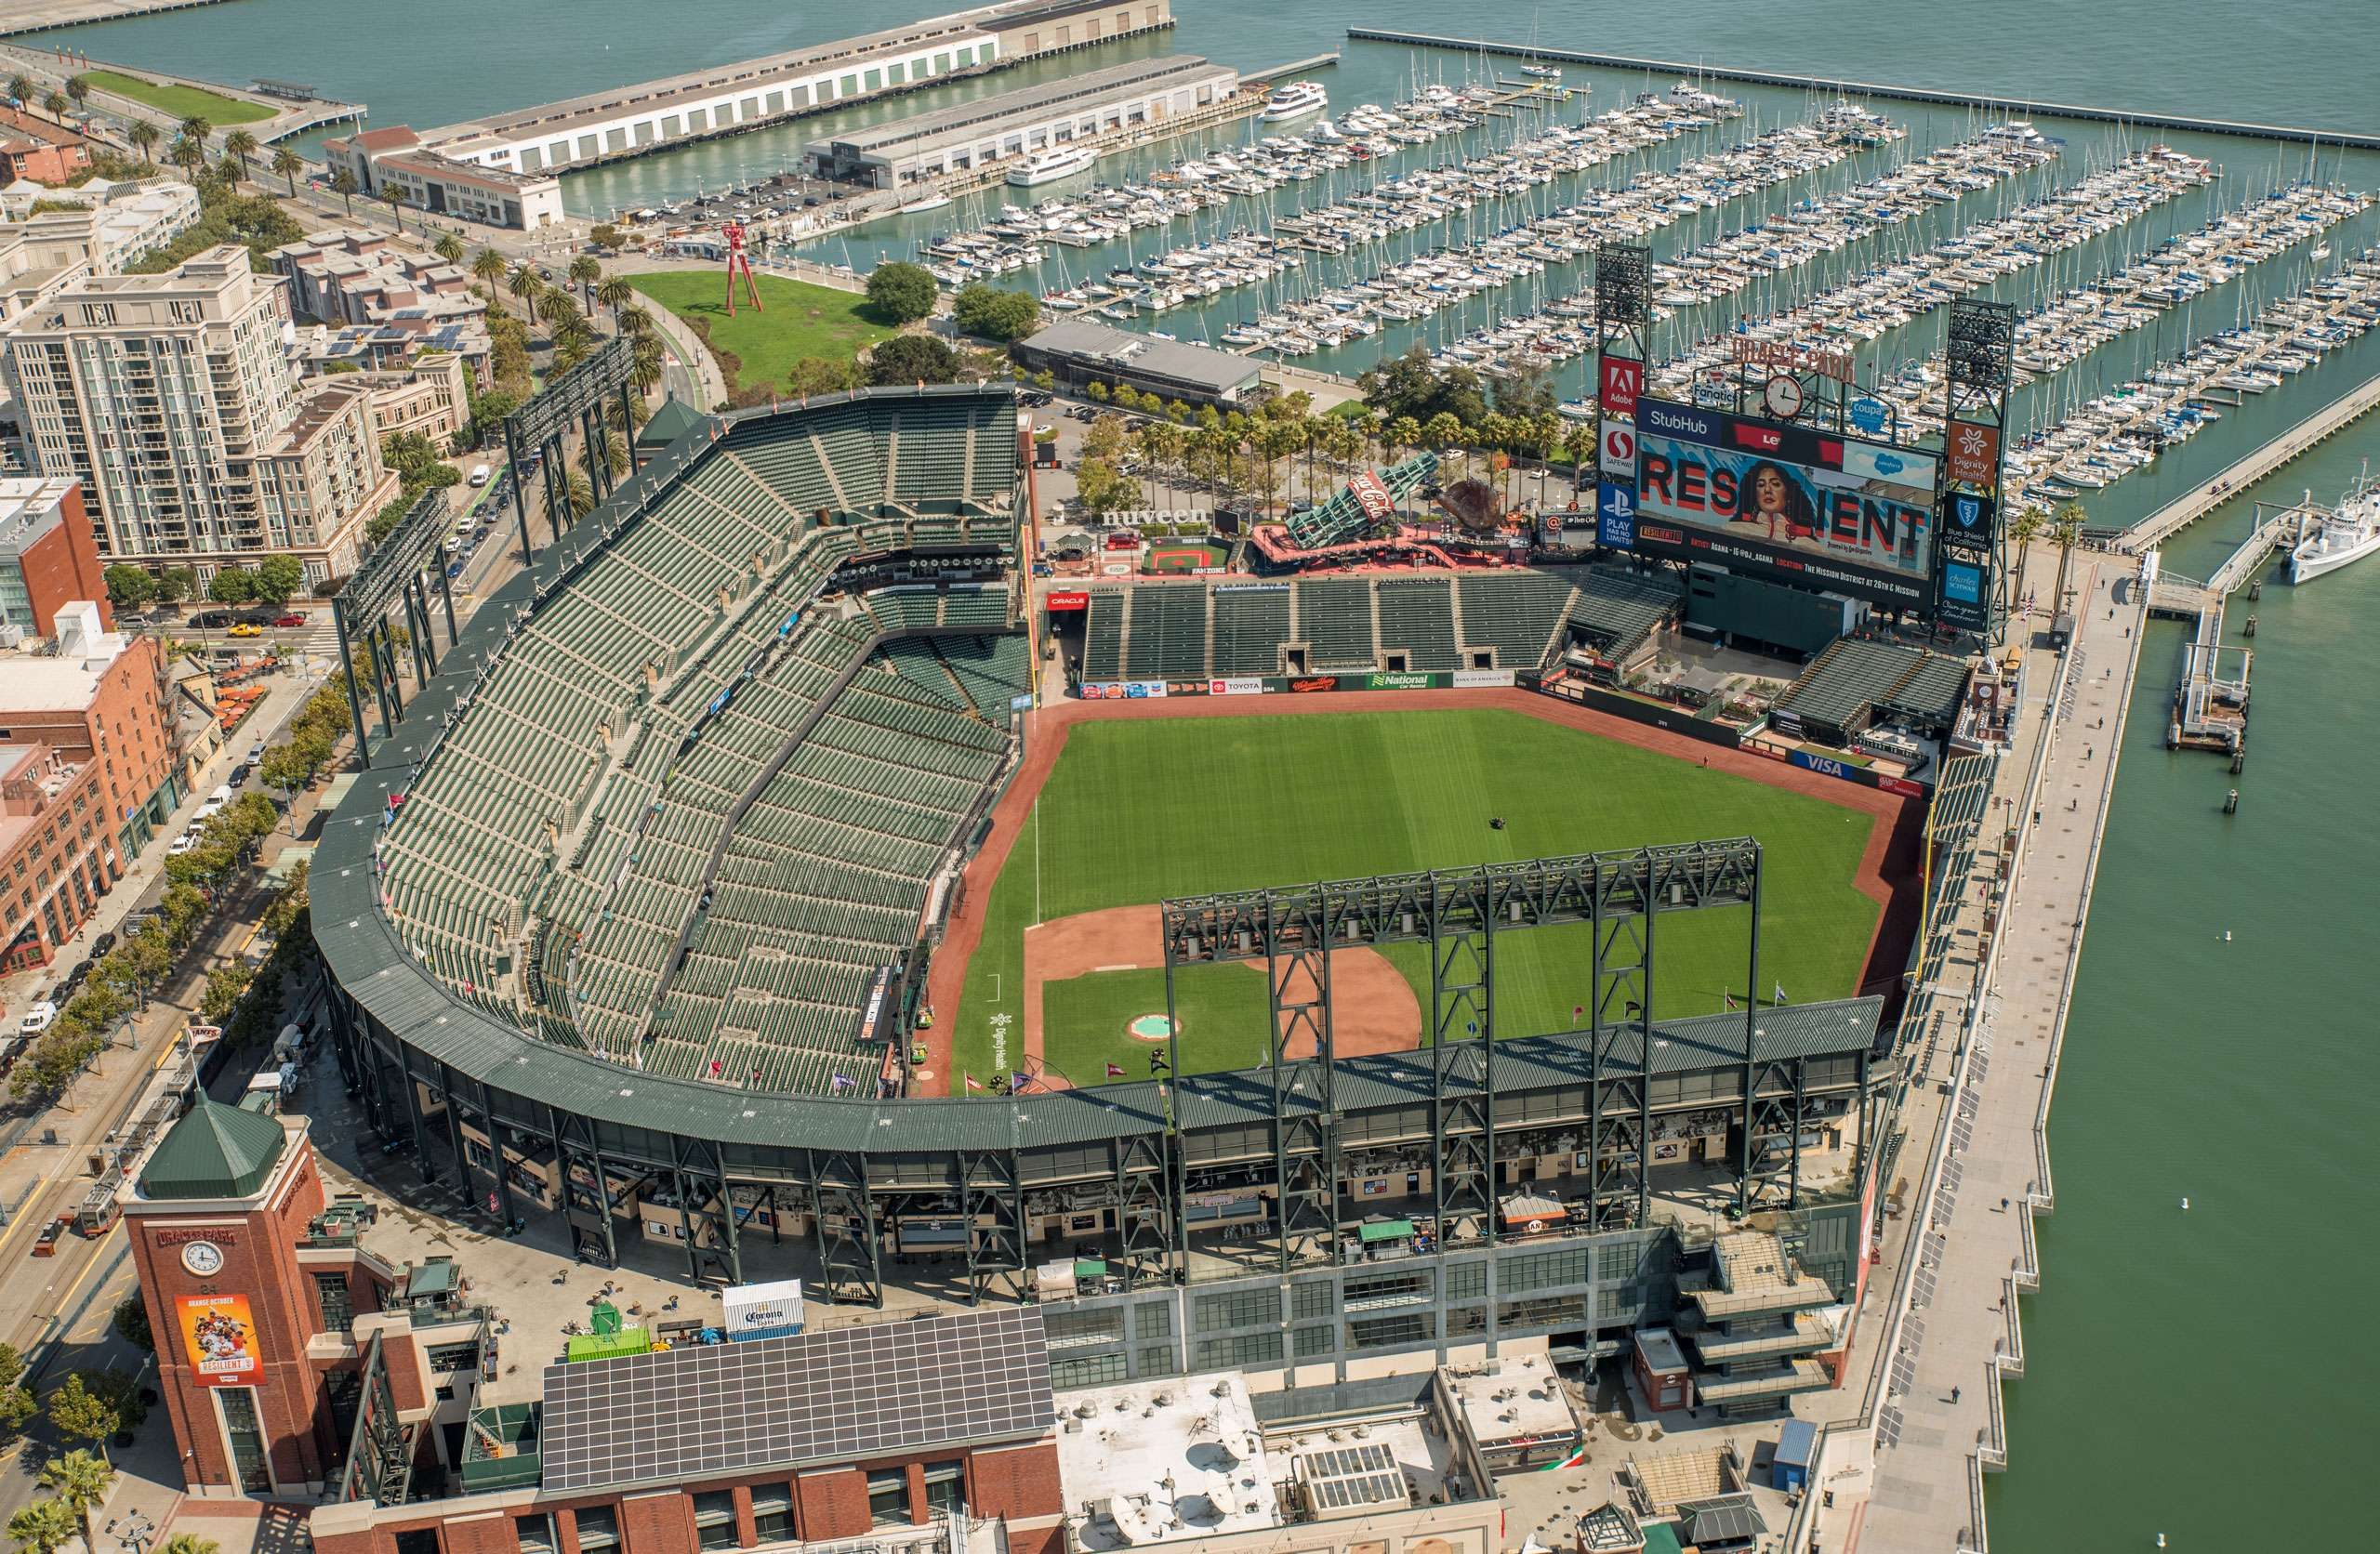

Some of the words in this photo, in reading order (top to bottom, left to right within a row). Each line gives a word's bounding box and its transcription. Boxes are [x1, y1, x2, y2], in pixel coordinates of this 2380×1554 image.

[1732, 336, 1801, 369] ORACLE
[1806, 349, 1857, 387] PARK
[1610, 393, 1633, 406] Adobe
[1694, 384, 1738, 402] Fanatics
[1853, 403, 1883, 417] coupa
[1650, 411, 1708, 434] StubHub
[1606, 457, 1633, 468] SAFEWAY
[1953, 455, 1989, 473] Dignity
[1955, 468, 1987, 482] Health
[1102, 507, 1208, 526] nuveen
[1606, 518, 1631, 532] PLAY
[1606, 526, 1620, 535] HAS
[1620, 529, 1631, 538] NO
[1606, 533, 1630, 545] LIMITS
[1947, 527, 1963, 537] Blue
[1964, 529, 1985, 541] Shield
[1952, 535, 1987, 549] California
[1816, 565, 1840, 579] MISSION
[1840, 571, 1865, 586] DISTRICT
[1895, 583, 1920, 598] MISSION
[1949, 573, 1975, 586] charles
[1948, 581, 1977, 593] SCHWAB
[1228, 682, 1260, 691] TOYOTA
[1384, 674, 1428, 685] National
[1805, 755, 1843, 777] VISA
[992, 1028, 1007, 1049] Dignity
[996, 1049, 1007, 1071] Health
[200, 1284, 218, 1295] 24
[746, 1310, 783, 1323] Corona
[203, 1360, 241, 1371] RESILIENT
